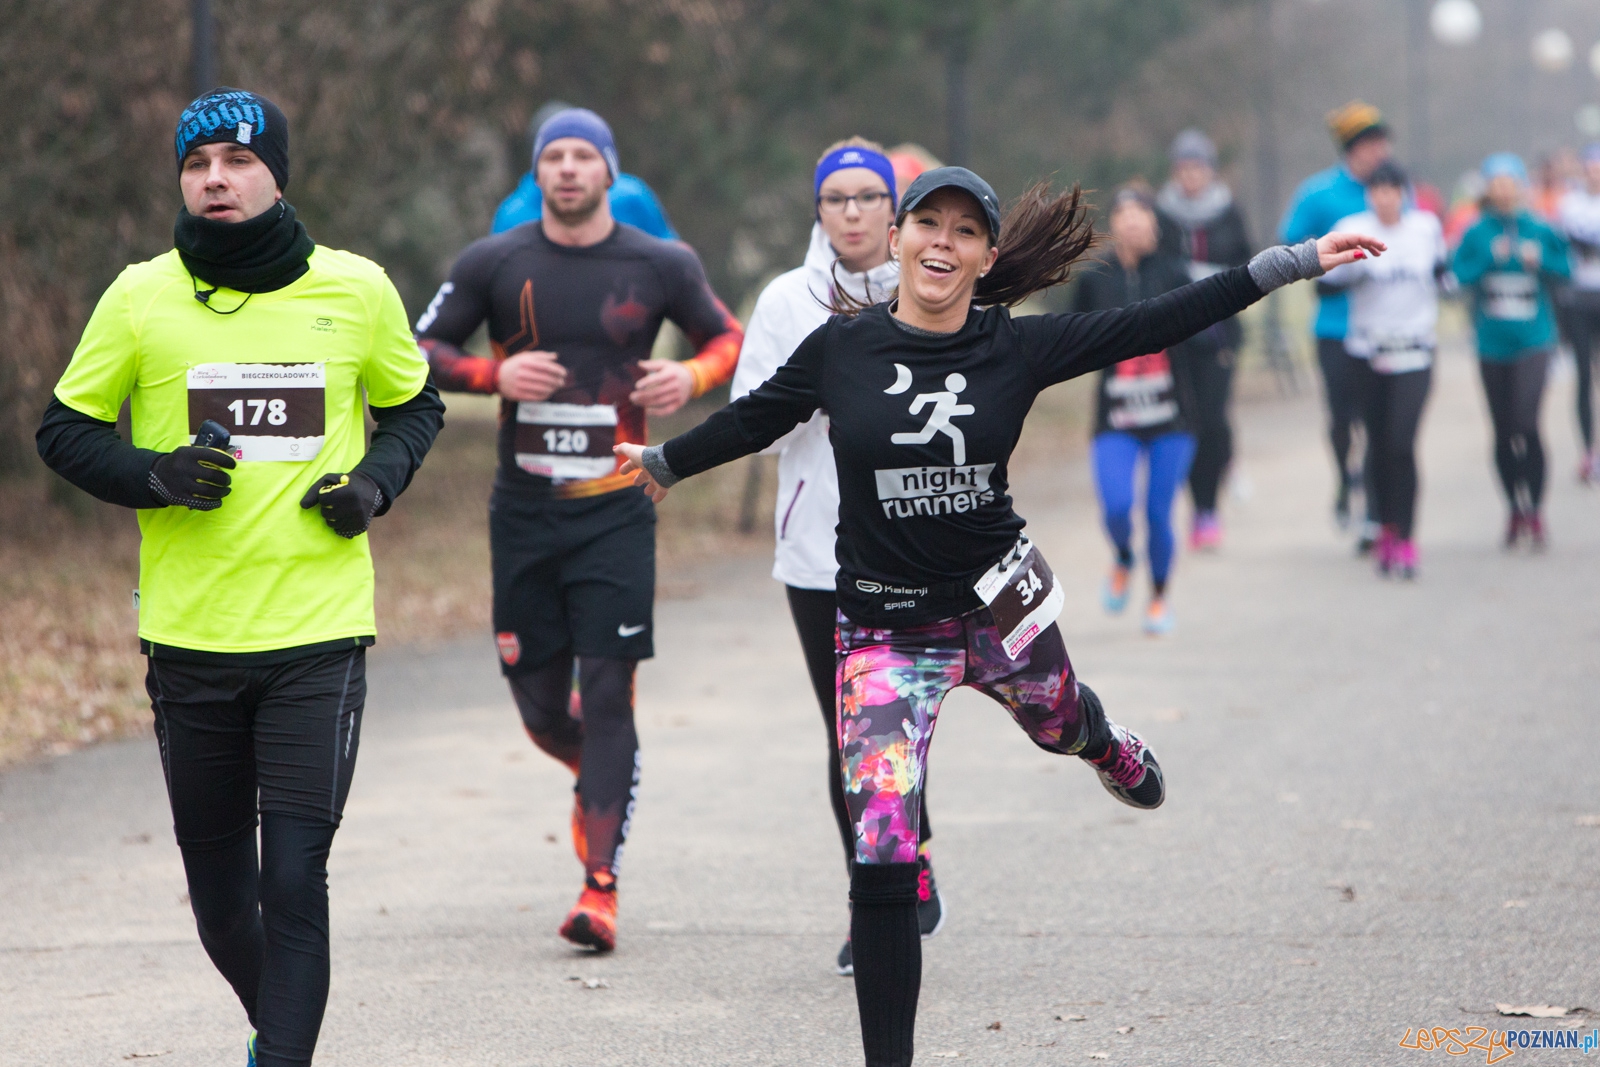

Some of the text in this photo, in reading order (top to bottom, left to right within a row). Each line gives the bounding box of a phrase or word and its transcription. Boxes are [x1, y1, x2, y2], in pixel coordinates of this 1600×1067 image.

[227, 399, 288, 426] 178
[543, 429, 588, 453] 120
[902, 467, 978, 494] night
[881, 490, 996, 520] runners
[884, 585, 928, 597] Kalenji
[1016, 567, 1043, 606] 34
[884, 600, 916, 611] SPIRO
